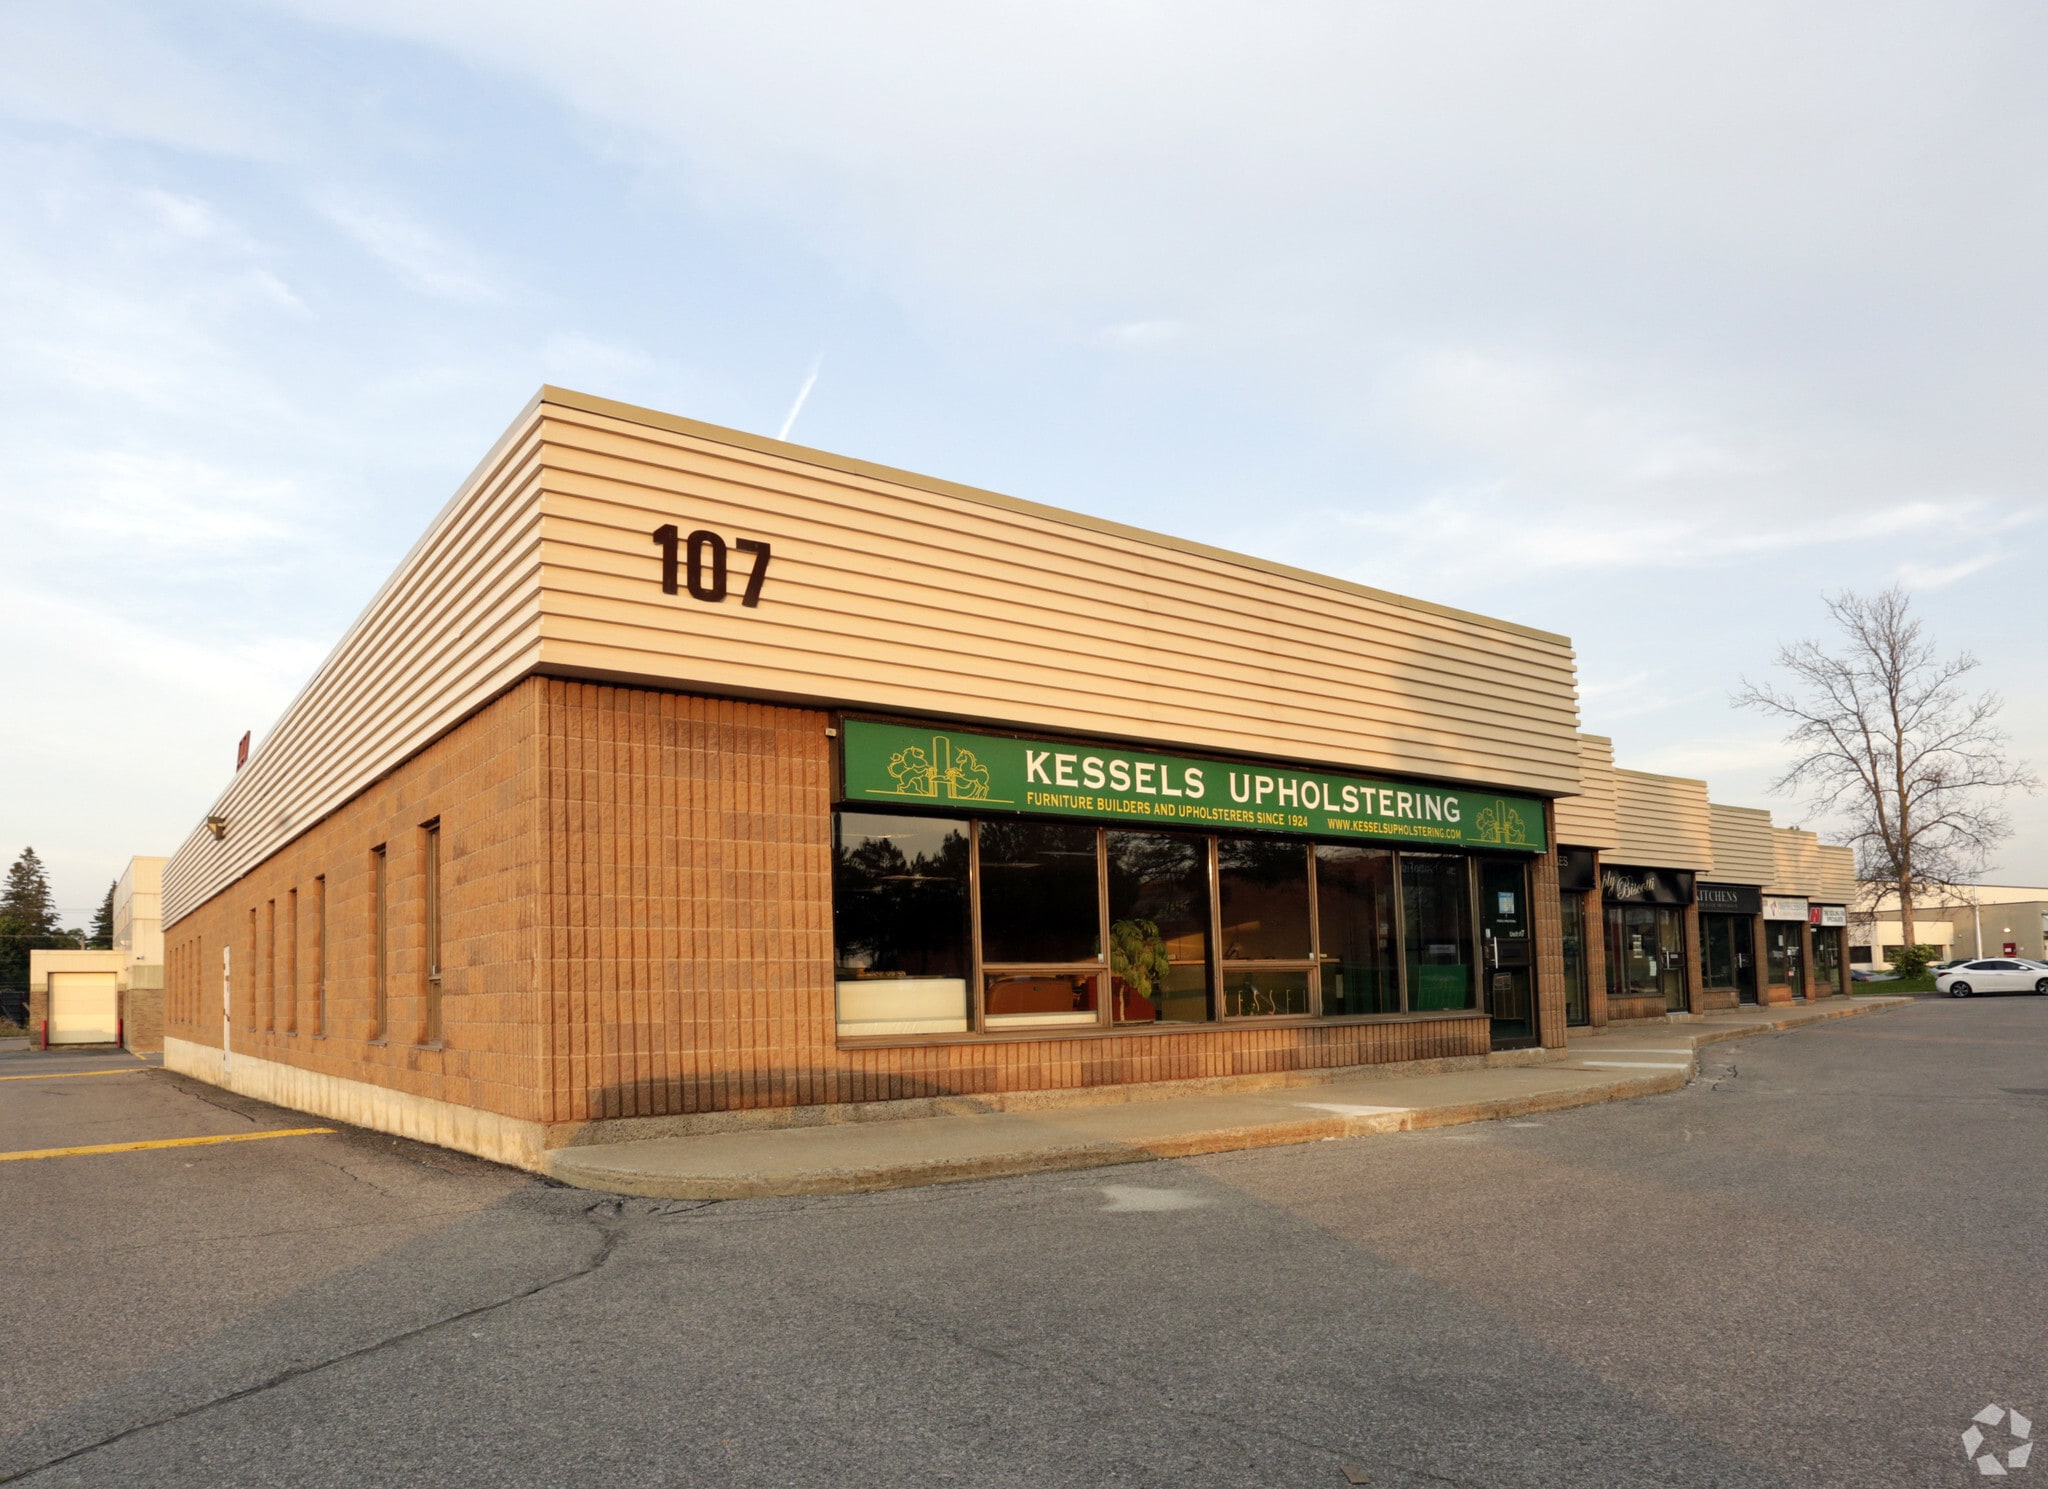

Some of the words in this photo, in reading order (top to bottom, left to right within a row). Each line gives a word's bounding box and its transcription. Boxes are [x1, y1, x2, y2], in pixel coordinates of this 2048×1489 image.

[653, 524, 771, 608] 107
[1025, 749, 1205, 799] KESSELS
[1229, 771, 1461, 823] UPHOLSTERING
[1026, 791, 1094, 810] FURNITURE
[1096, 797, 1151, 815] BUILDERS
[1153, 803, 1176, 817] AND
[1178, 805, 1255, 823] UPHOLSTERERS
[1256, 811, 1285, 826] SINCE
[1287, 814, 1309, 827] 1924
[1327, 818, 1461, 839] WWW.KESSELSUPHOLSTERING.COM
[1557, 855, 1568, 866] ES
